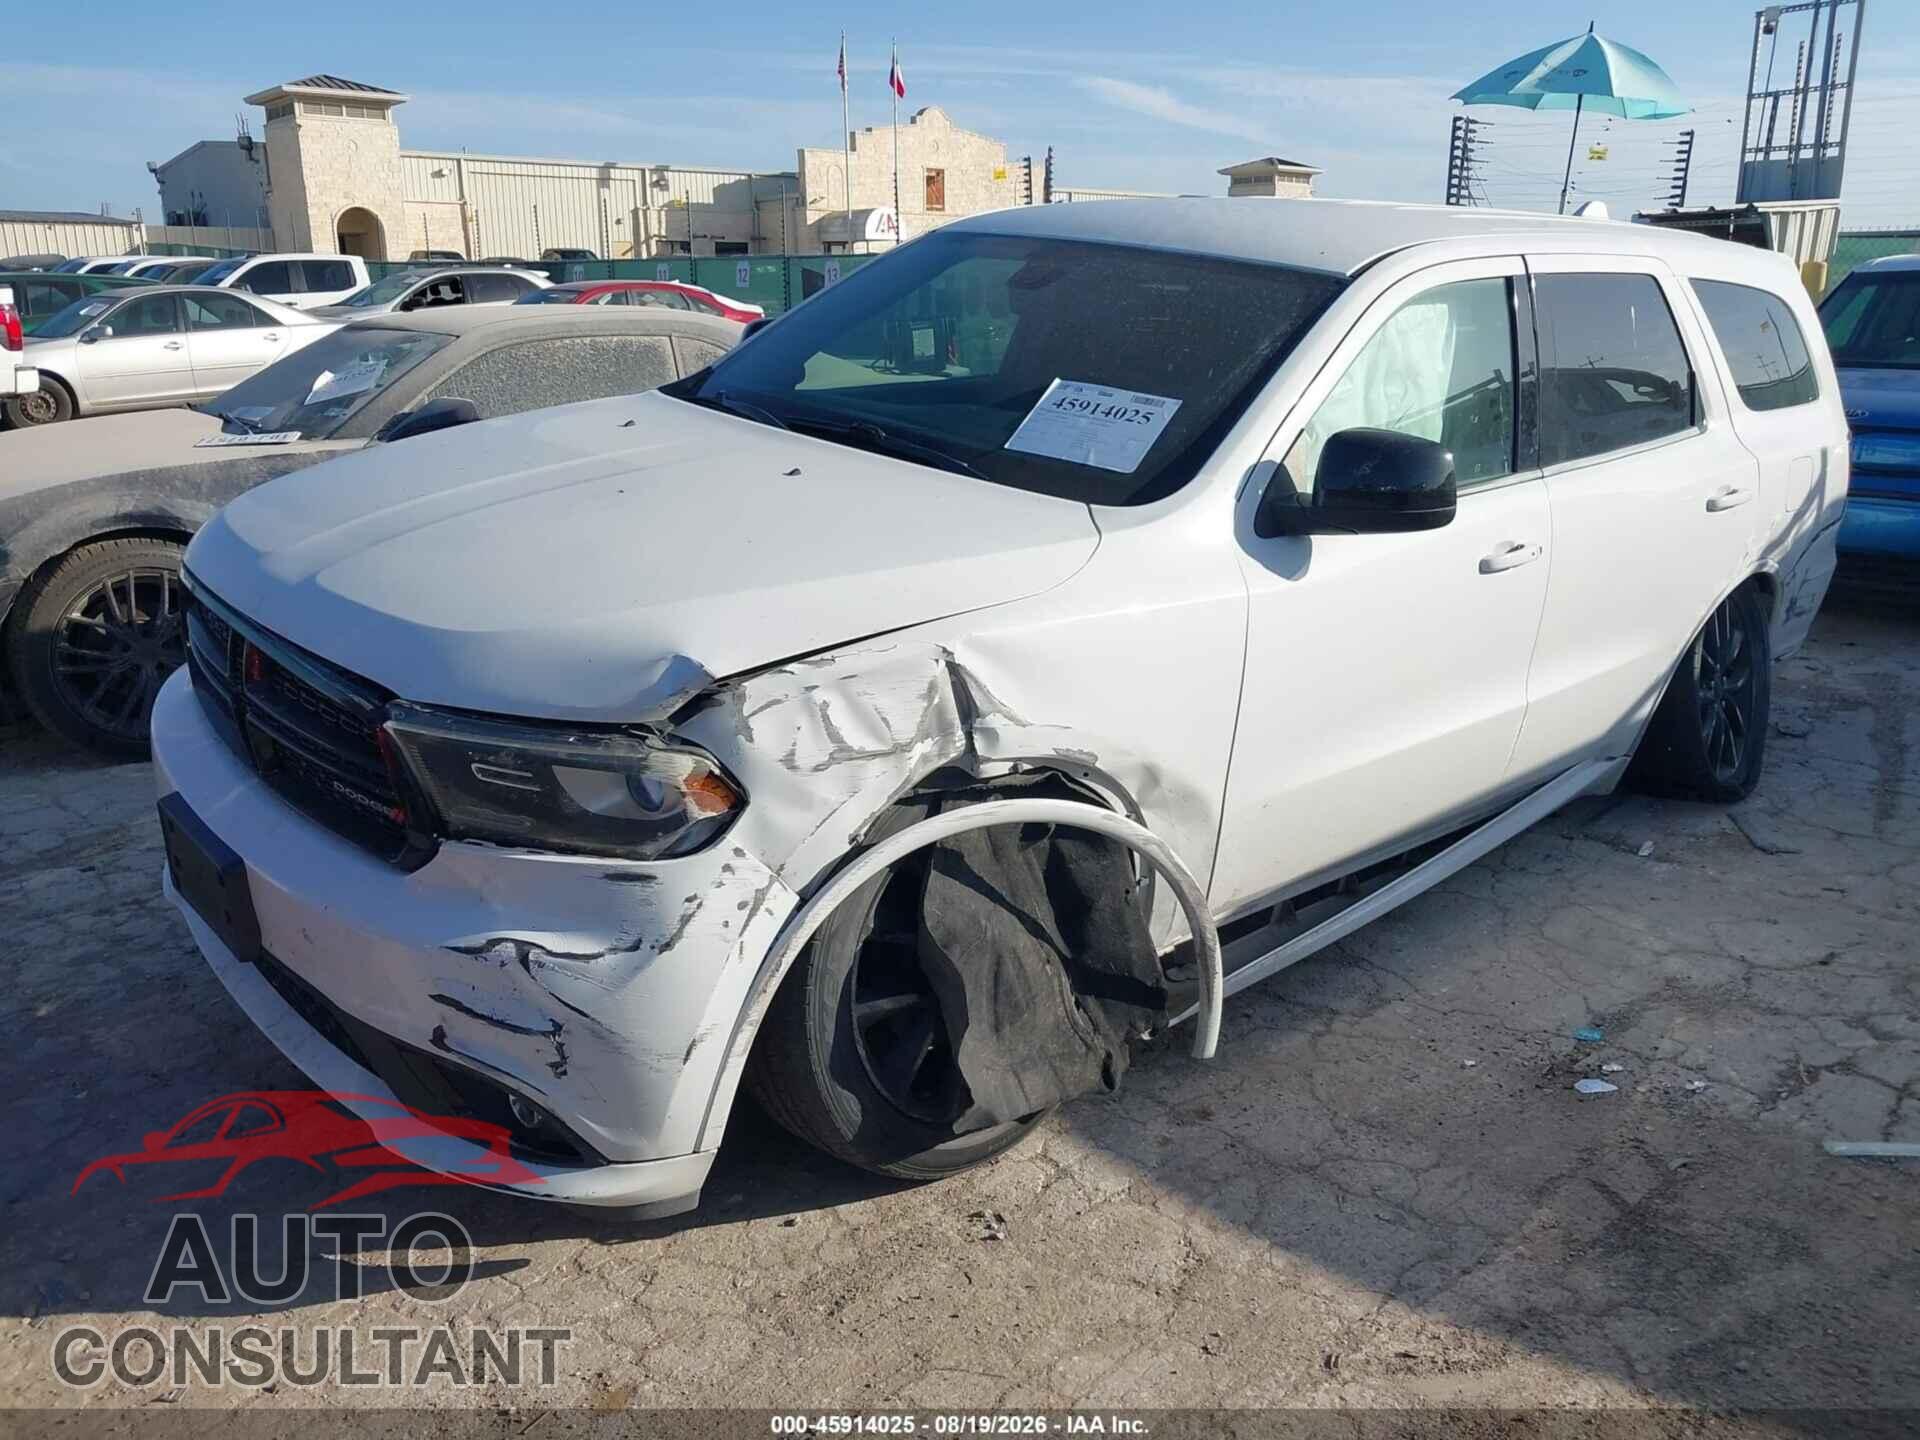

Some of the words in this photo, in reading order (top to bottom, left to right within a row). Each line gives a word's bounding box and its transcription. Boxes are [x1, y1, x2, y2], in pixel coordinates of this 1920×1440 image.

[738, 268, 748, 283] 12
[827, 267, 838, 283] 13
[1052, 396, 1155, 424] 45914025
